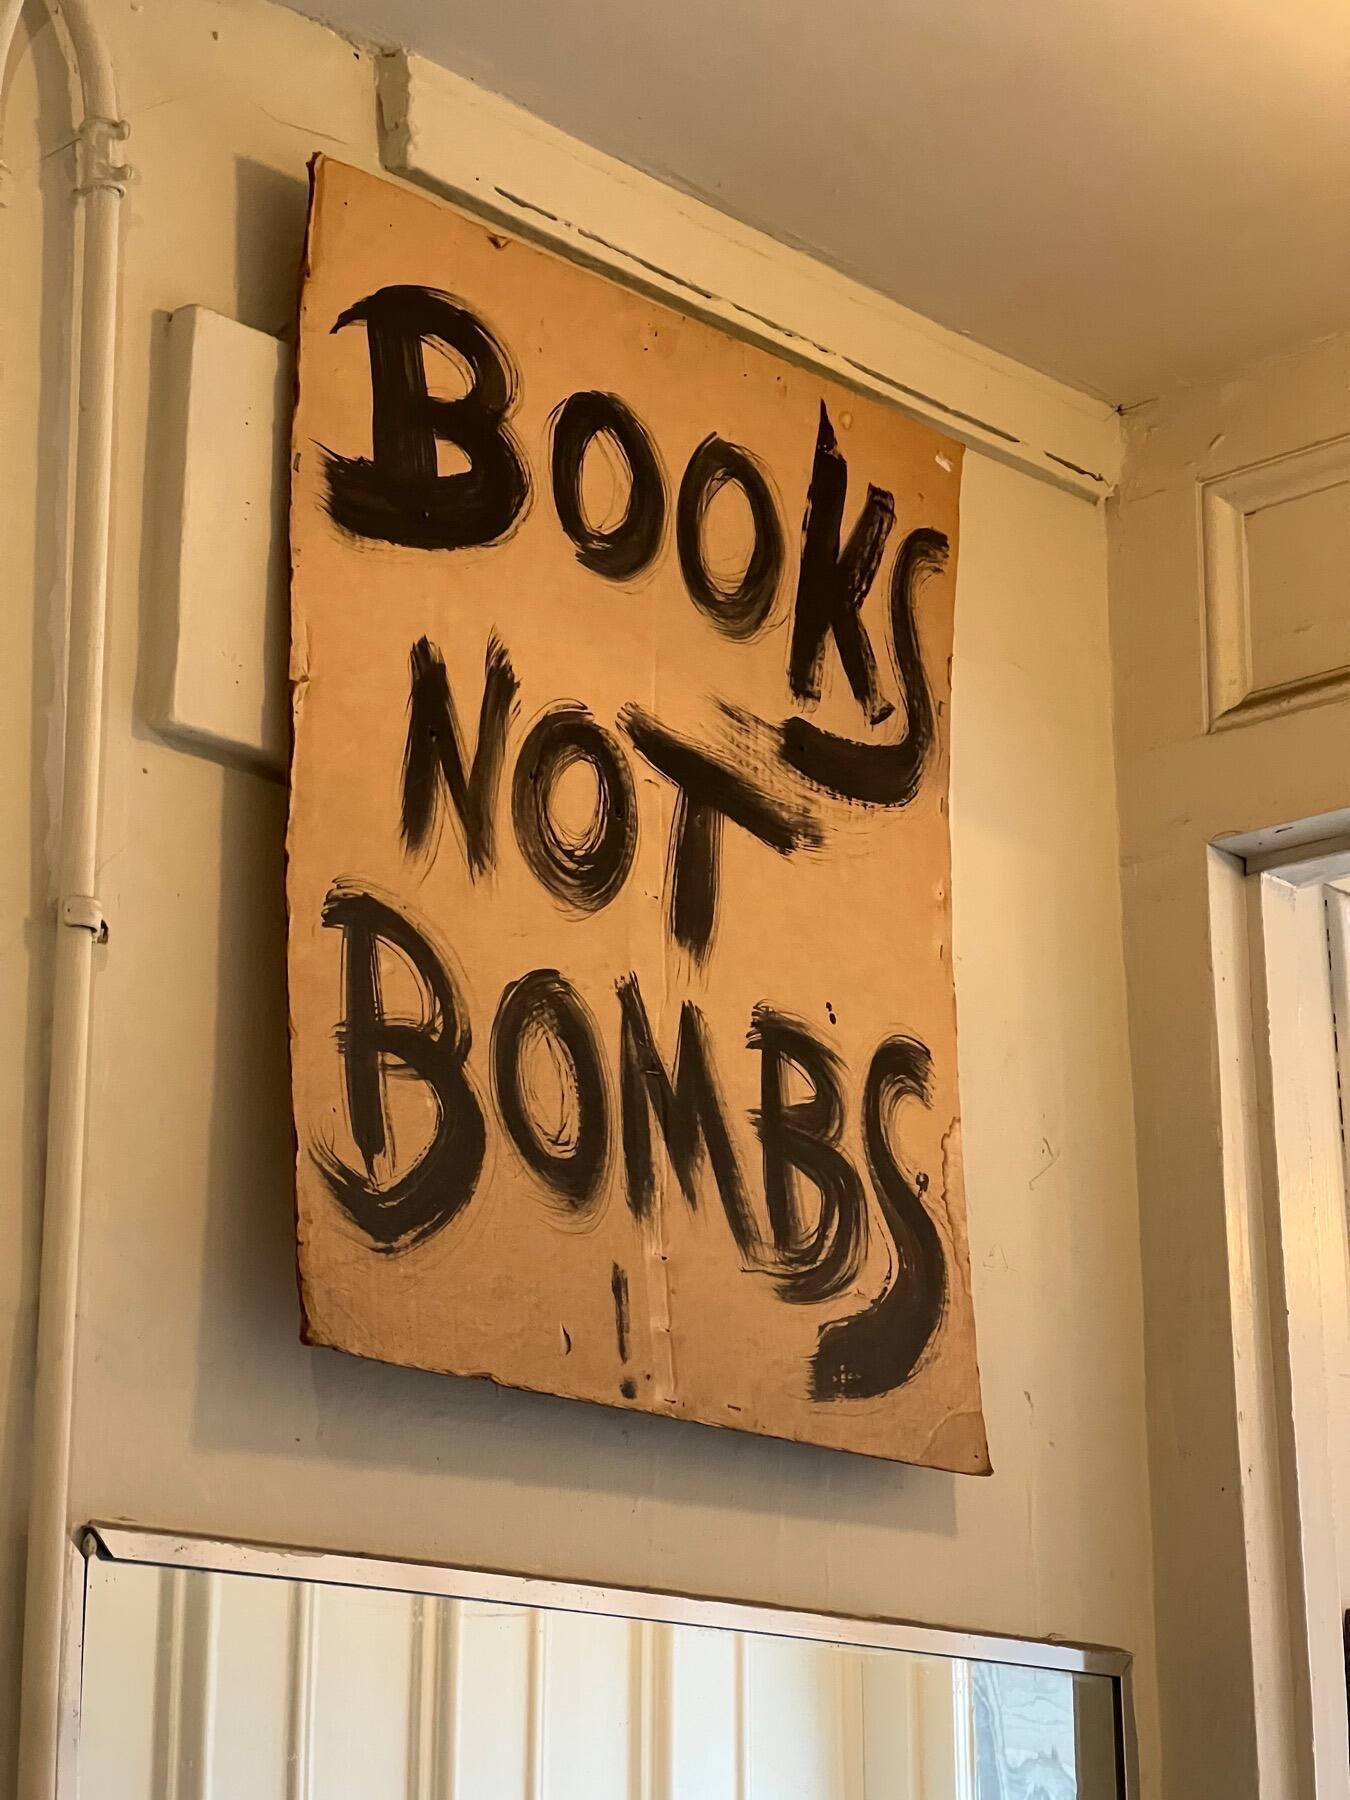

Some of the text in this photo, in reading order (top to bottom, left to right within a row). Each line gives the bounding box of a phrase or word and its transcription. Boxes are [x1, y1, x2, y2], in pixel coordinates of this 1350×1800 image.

[309, 286, 949, 807] BOOKS
[400, 630, 828, 972] NOT
[308, 880, 950, 1401] BOMBS
